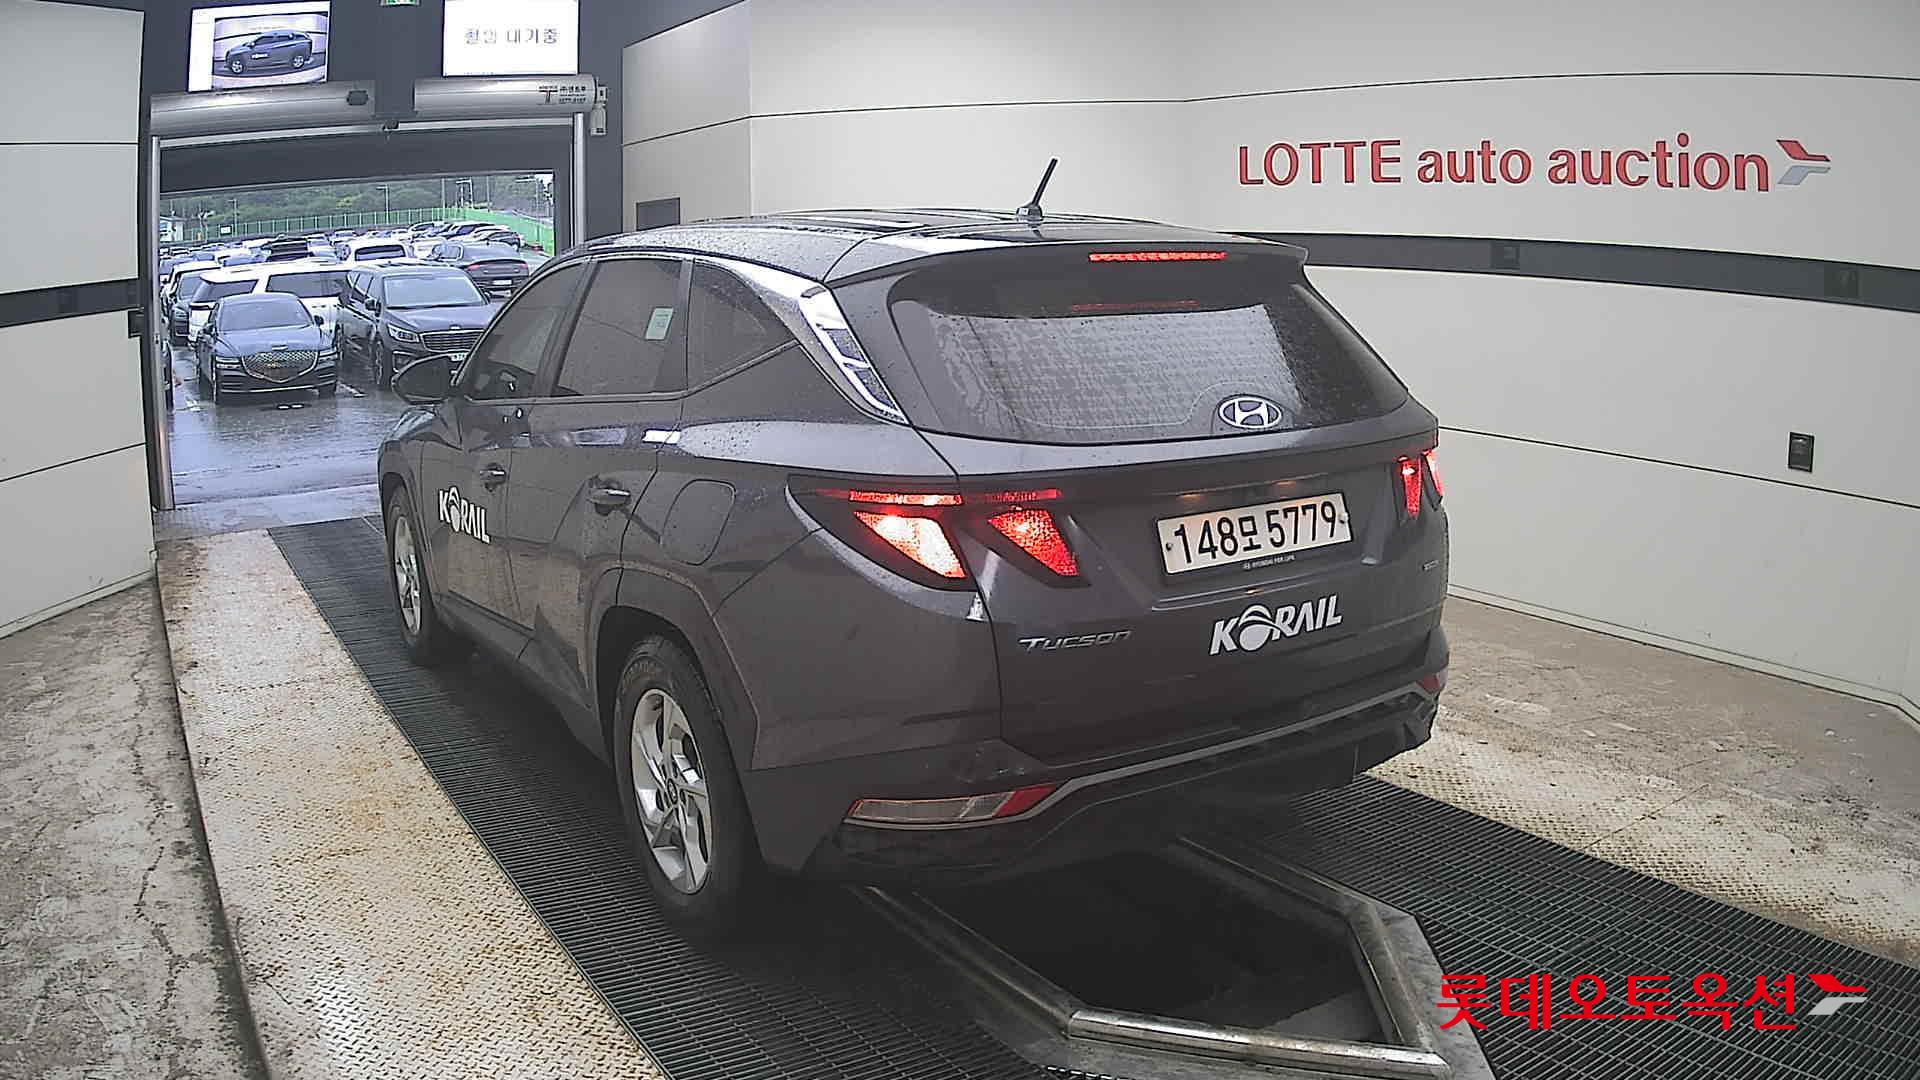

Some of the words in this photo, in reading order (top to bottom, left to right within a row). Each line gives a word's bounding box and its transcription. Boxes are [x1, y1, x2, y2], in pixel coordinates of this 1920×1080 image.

[507, 28, 559, 44] 대기중
[1239, 140, 1401, 185] LOTTE
[1417, 140, 1532, 184] auto
[1549, 133, 1769, 192] auction
[439, 486, 491, 545] KORAIL
[1266, 501, 1336, 548] 5779
[1209, 594, 1342, 655] KORAIL
